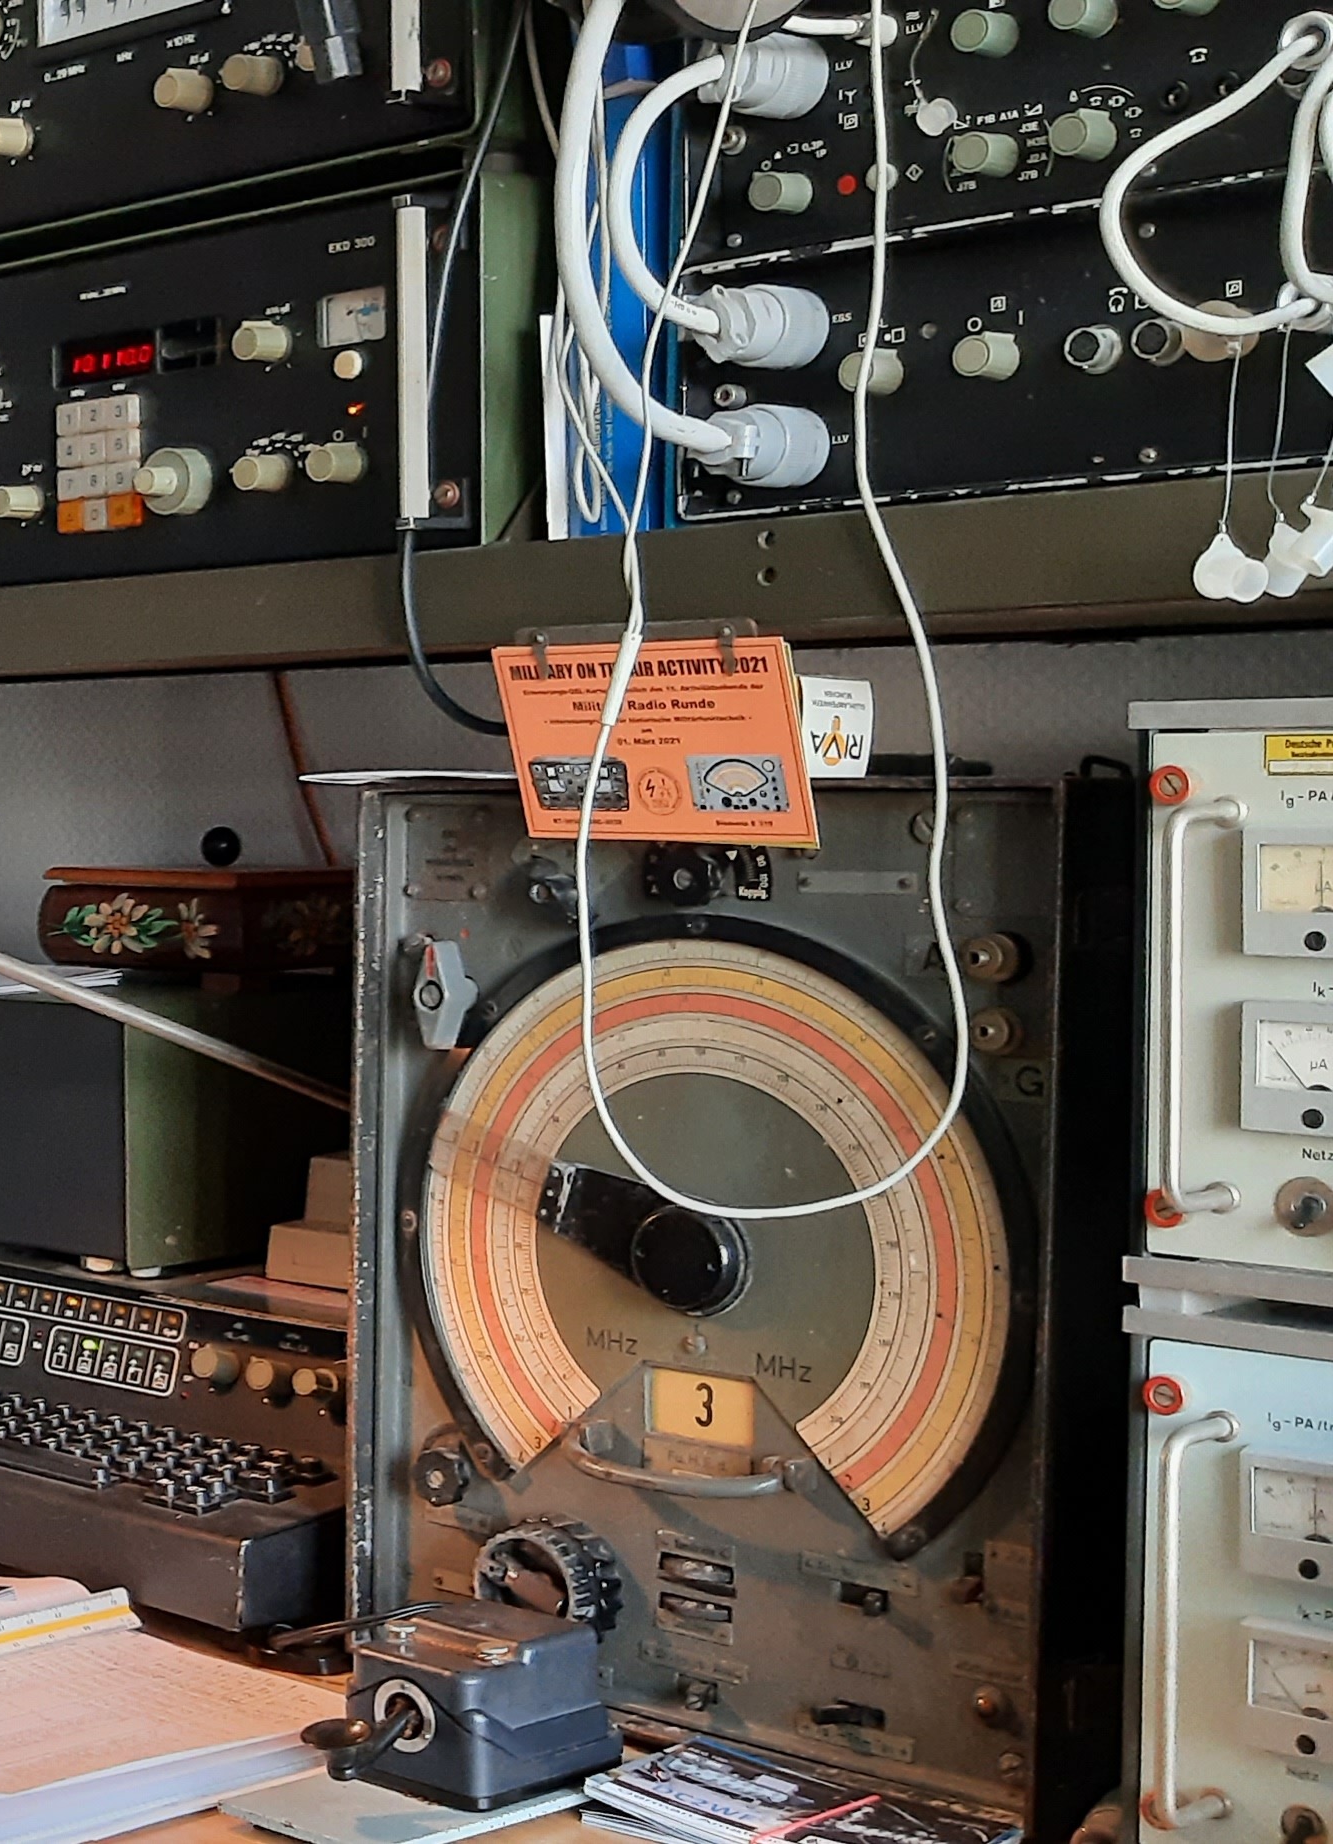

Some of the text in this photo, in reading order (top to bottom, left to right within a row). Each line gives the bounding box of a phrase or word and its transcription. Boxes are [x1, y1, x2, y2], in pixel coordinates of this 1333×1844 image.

[328, 235, 376, 254] EKD 300
[509, 663, 572, 680] MILIARY
[577, 662, 596, 678] ON
[658, 659, 725, 676] ACTIVITY
[734, 656, 768, 674] 2021
[628, 699, 715, 711] Radio Runde
[810, 730, 864, 761] RIVA
[1285, 739, 1322, 749] Deutsche
[1015, 1066, 1045, 1098] G
[1302, 1148, 1333, 1161] Netz
[585, 1326, 638, 1355] MHz
[755, 1352, 813, 1384] MHz
[694, 1382, 714, 1427] 3
